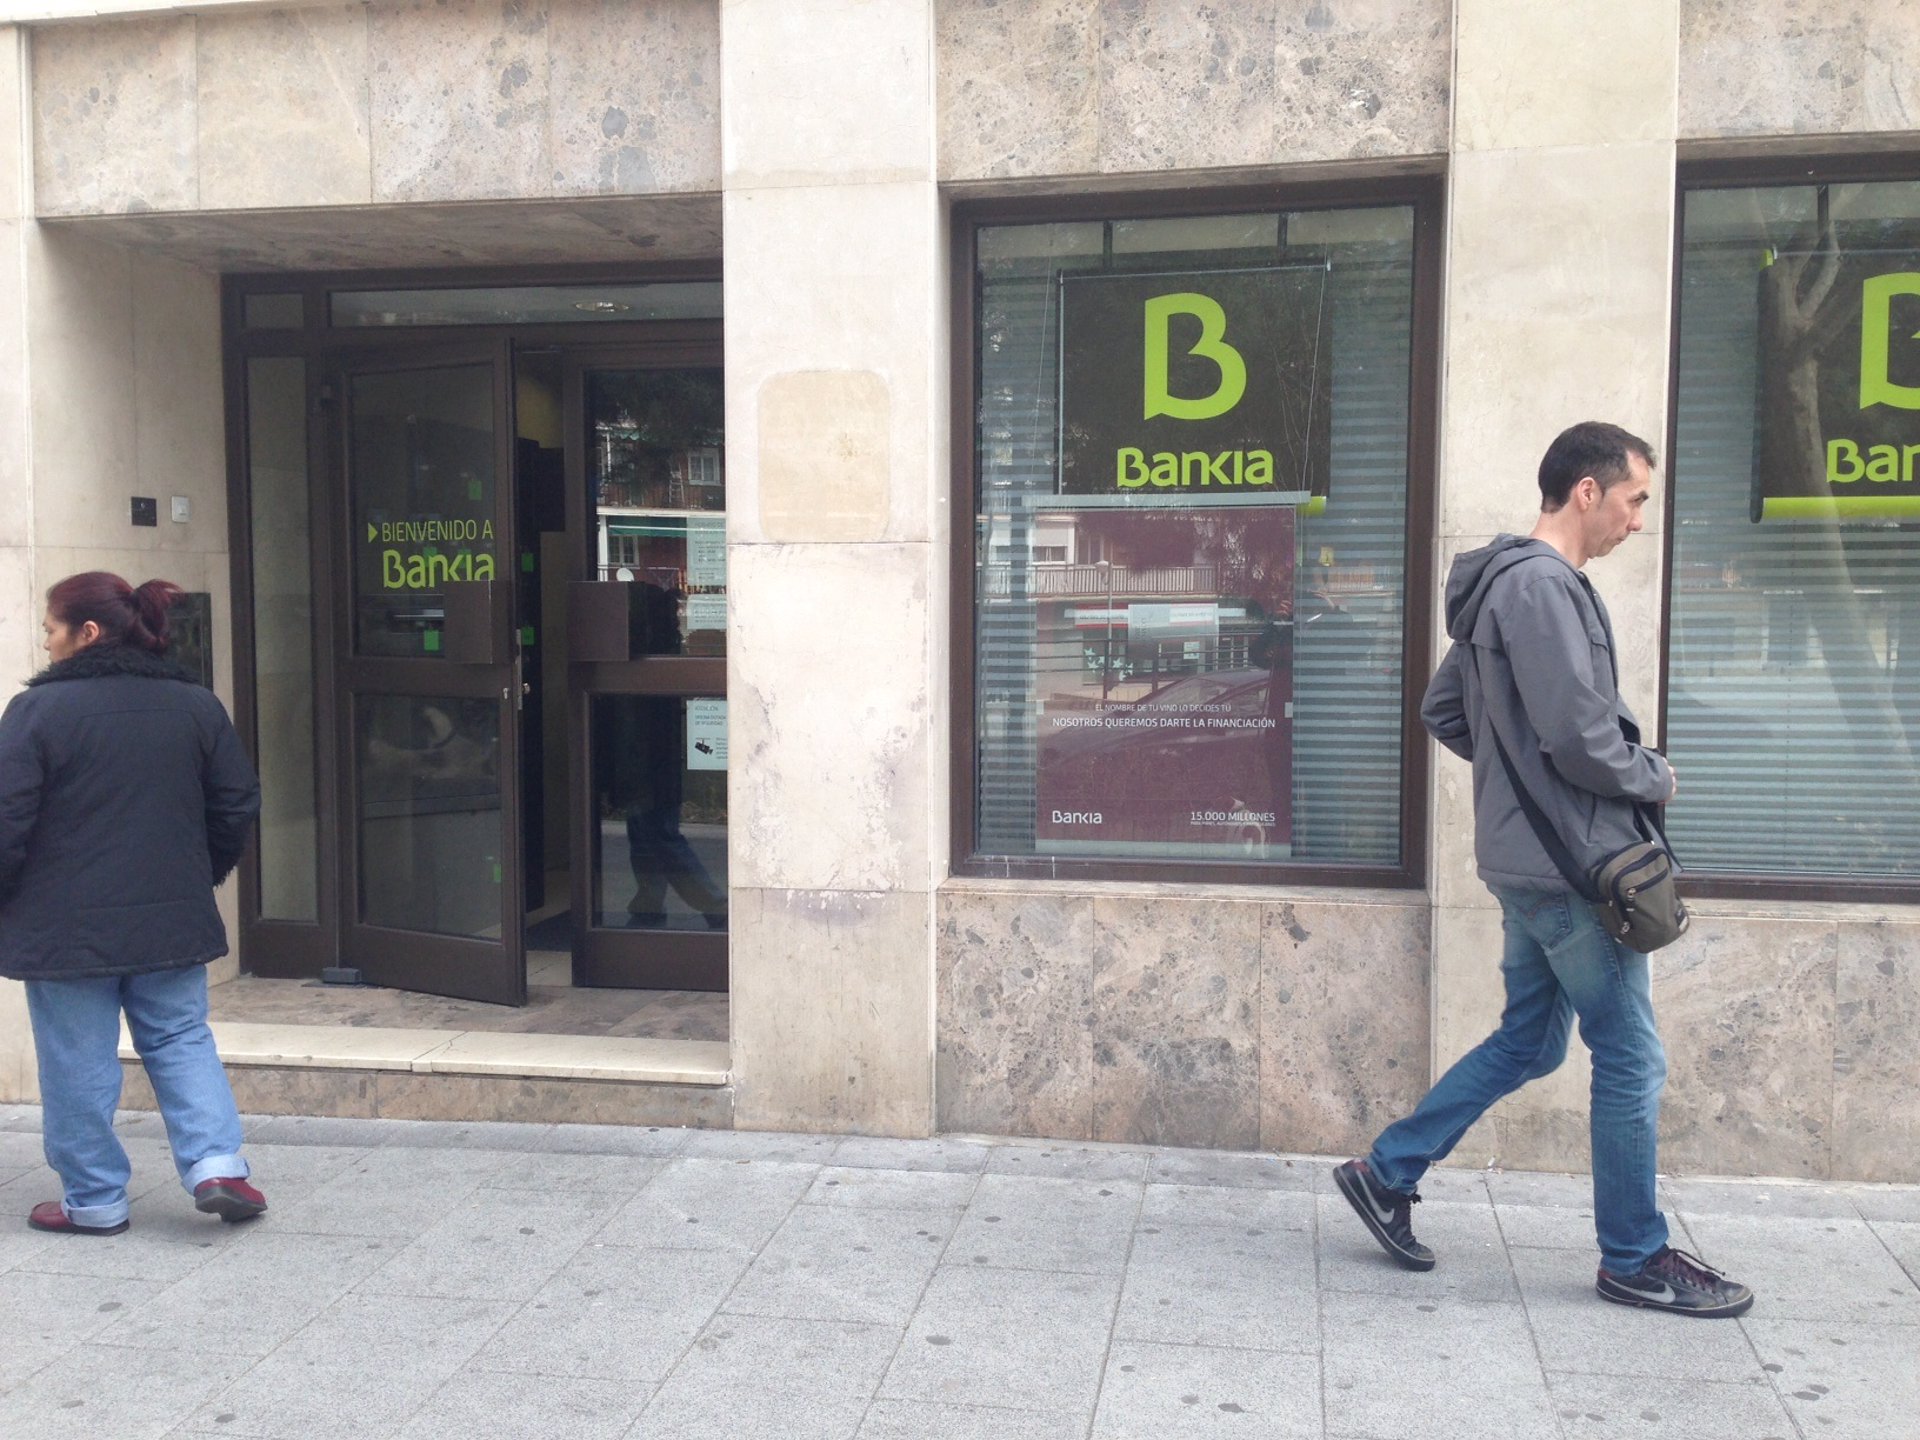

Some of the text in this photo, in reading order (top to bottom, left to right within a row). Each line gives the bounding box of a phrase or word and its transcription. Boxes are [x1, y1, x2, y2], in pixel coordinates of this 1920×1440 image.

[1143, 291, 1248, 421] B
[1116, 446, 1274, 488] Bankia
[381, 518, 494, 542] BIENVENIDO A
[382, 548, 495, 589] Bankia
[1095, 703, 1104, 712] EL
[1105, 703, 1136, 712] NOMBRE
[1137, 703, 1148, 713] DE
[1149, 704, 1159, 712] TU
[1189, 704, 1220, 713] DECIDES
[1052, 716, 1276, 729] NOSOTROS QUEREMOS DARTE LA FINANCIACIÓN
[1052, 810, 1103, 825] Bankia
[1191, 811, 1276, 822] 15.000 MILLONES
